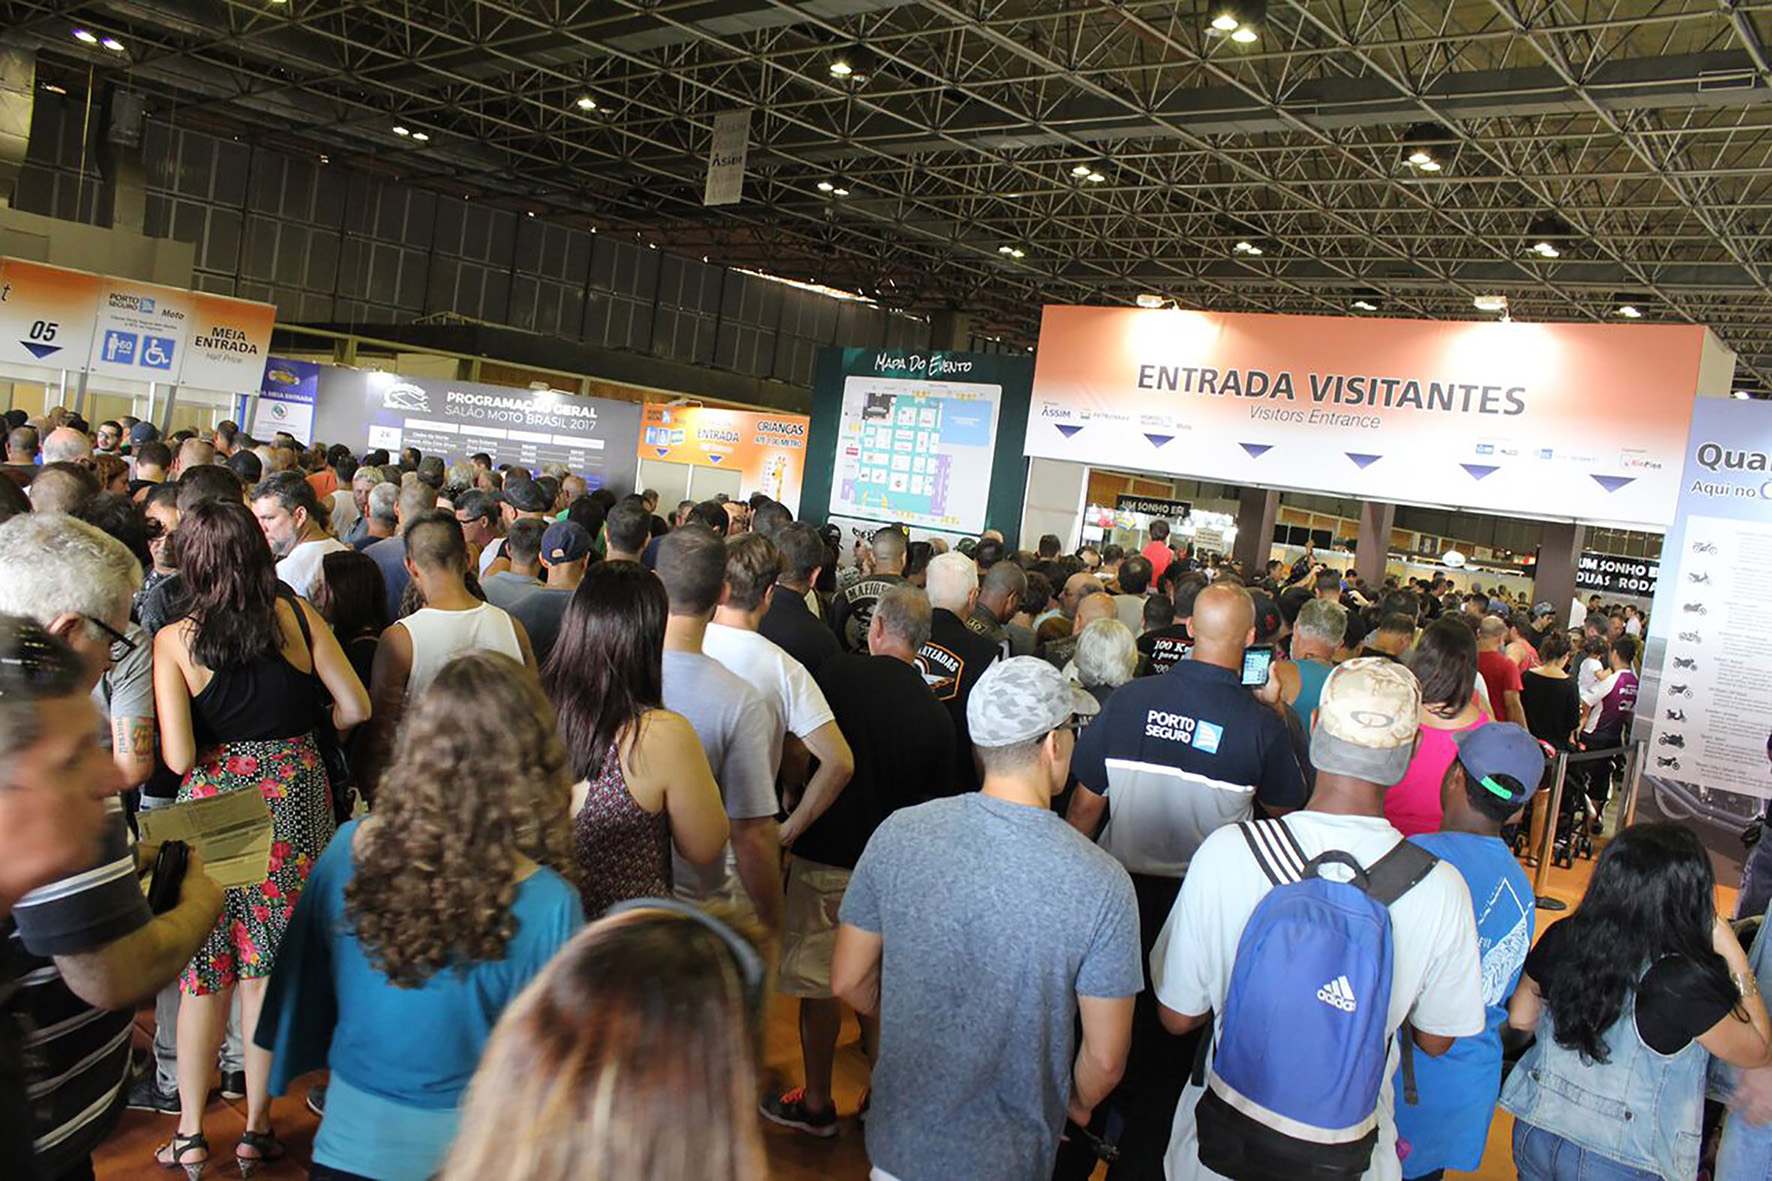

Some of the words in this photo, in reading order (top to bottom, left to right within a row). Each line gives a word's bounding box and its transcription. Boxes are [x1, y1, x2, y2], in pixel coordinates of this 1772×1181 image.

[109, 293, 140, 305] PORTO
[109, 301, 138, 311] SEGURO
[161, 308, 185, 320] Moto
[29, 320, 60, 342] 05
[211, 326, 246, 341] MEIA
[194, 335, 258, 355] ENTRADA
[223, 354, 244, 364] Price
[874, 352, 906, 371] MAPA
[1137, 364, 1295, 401] ENTRADA
[1309, 374, 1526, 416] VISITANTES
[446, 392, 551, 414] PROGRAMAÇÃO
[553, 403, 598, 419] GERAL
[444, 404, 485, 419] SALÃO
[487, 409, 523, 424] MOTO
[525, 413, 567, 429] BRASIL
[569, 418, 597, 431] 2017
[1249, 404, 1304, 424] Visitors
[1308, 407, 1381, 430] Entrance
[697, 428, 740, 443] ENTRADA
[756, 420, 804, 436] CRIANÇAS
[1691, 480, 1730, 496] Aqui
[1735, 486, 1756, 498] no
[1137, 501, 1169, 514] SONHO
[1578, 557, 1598, 570] UM
[1600, 560, 1646, 576] SONHO
[1576, 571, 1611, 587] DUAS
[1153, 640, 1173, 650] 100
[1147, 709, 1196, 733] PORTO
[1145, 724, 1192, 744] SEGURO
[1316, 988, 1357, 1012] adidas
